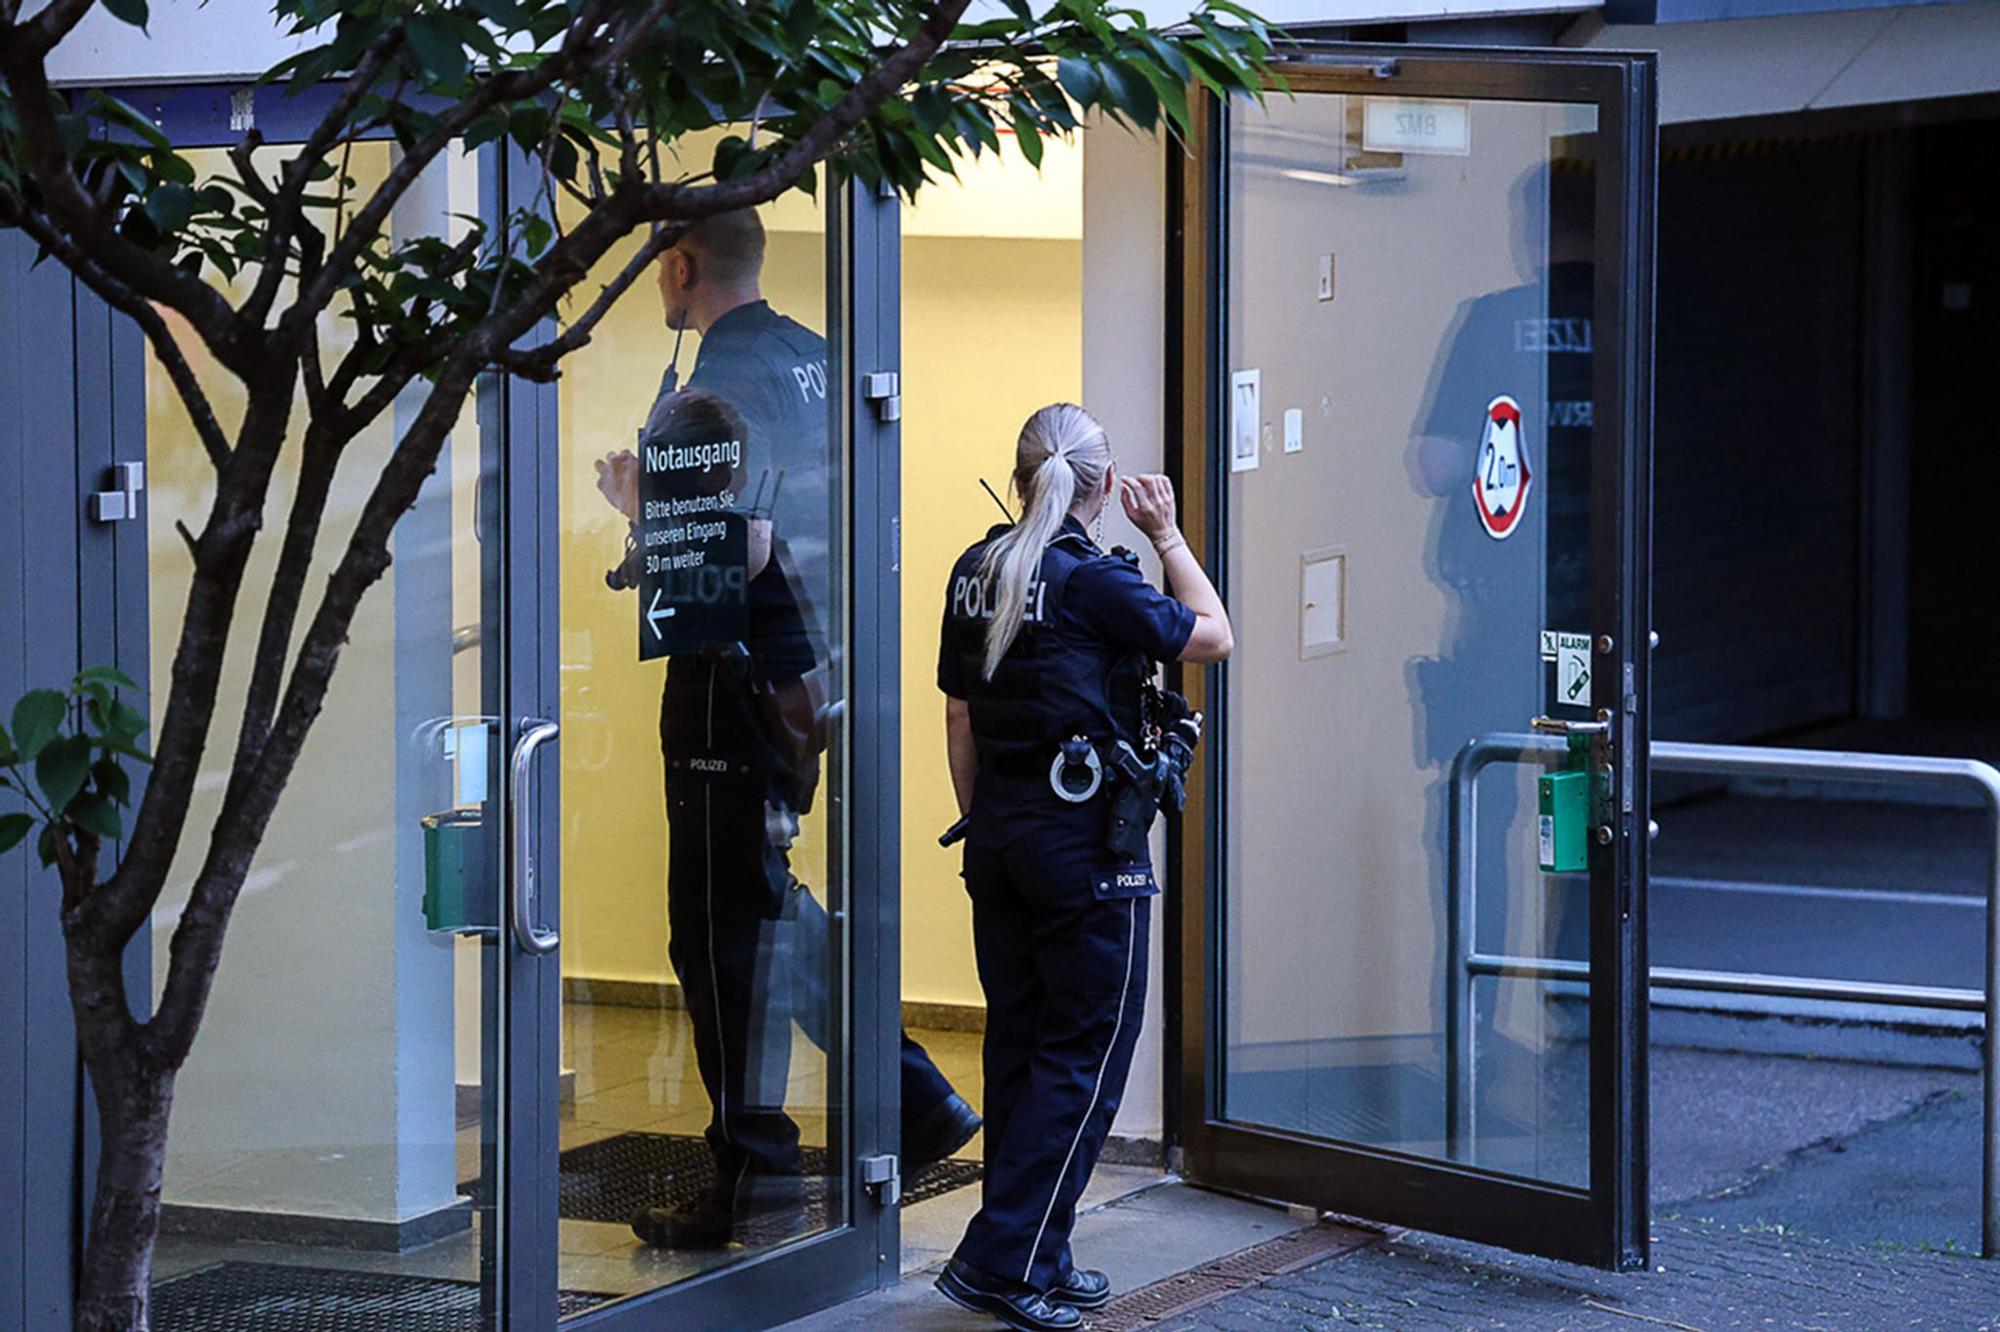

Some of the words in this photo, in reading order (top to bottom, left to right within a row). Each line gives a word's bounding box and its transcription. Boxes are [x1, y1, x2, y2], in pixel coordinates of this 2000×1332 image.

[646, 440, 741, 473] Notausgang
[645, 500, 671, 520] Bitte
[672, 496, 718, 516] benutzen
[719, 489, 735, 509] Sie
[645, 527, 686, 547] unseren
[687, 521, 727, 543] Eingang
[646, 554, 660, 574] 30
[661, 556, 672, 571] m
[672, 549, 706, 569] weiter
[953, 575, 1047, 621] POLIEI
[1560, 636, 1590, 651] ALARM
[690, 758, 728, 772] POLIZEI
